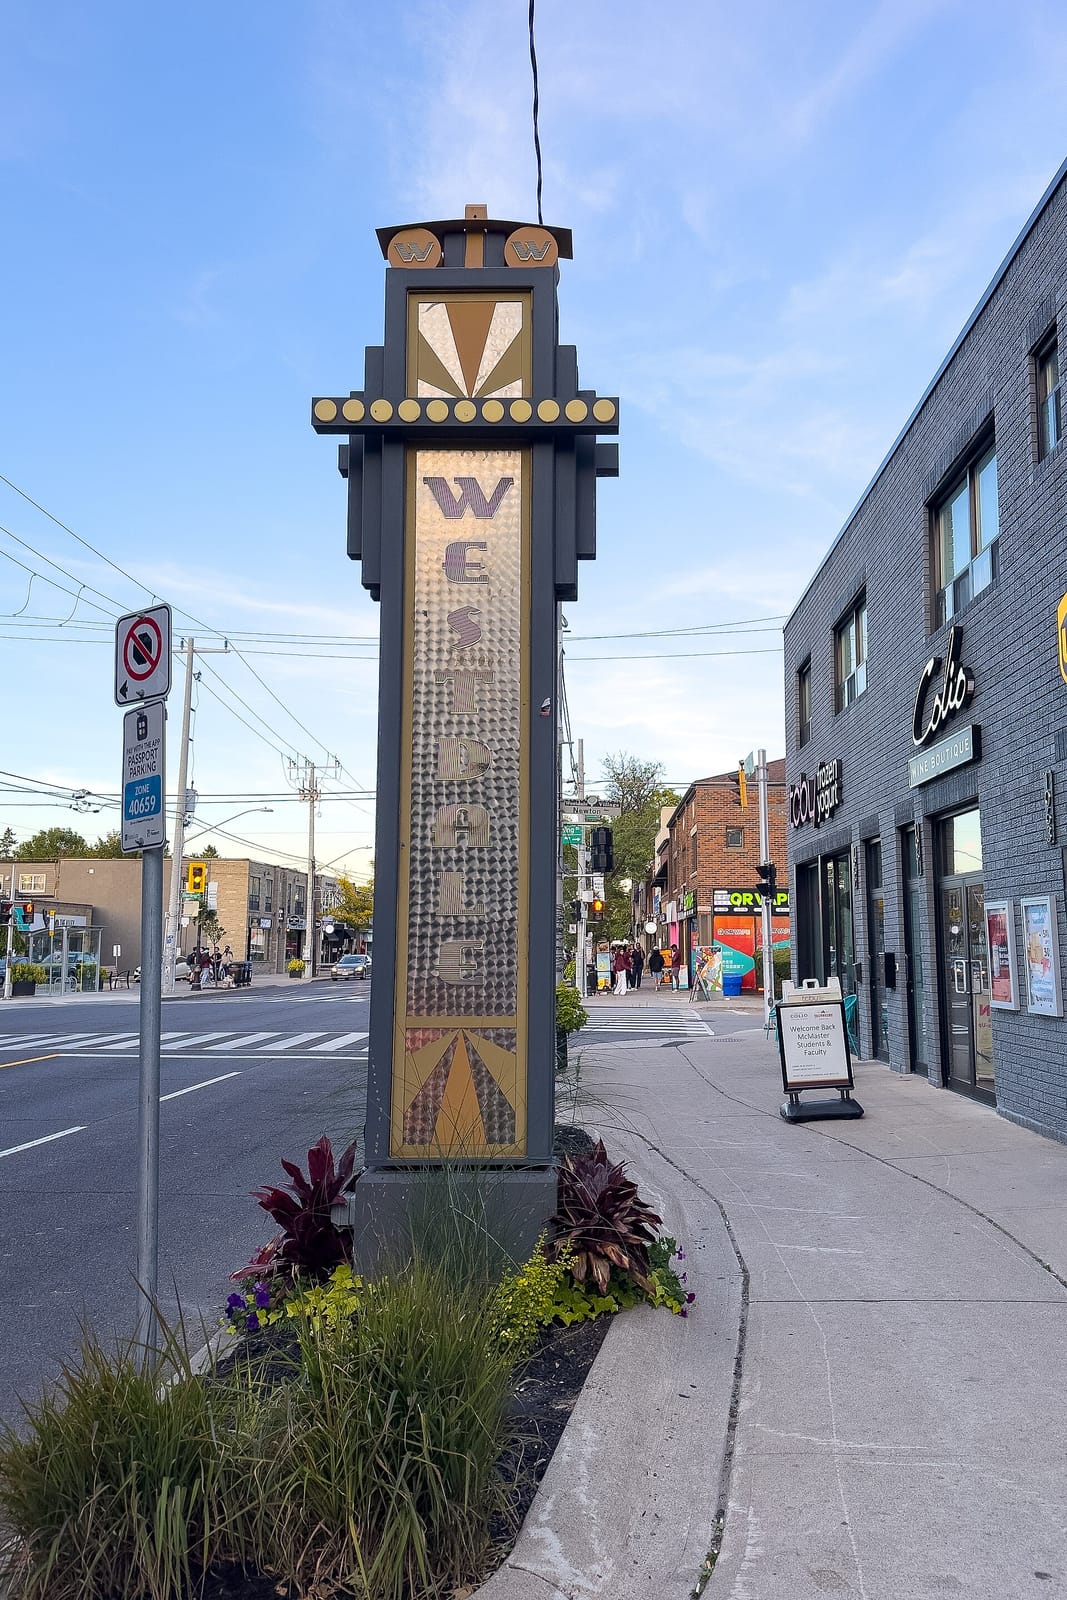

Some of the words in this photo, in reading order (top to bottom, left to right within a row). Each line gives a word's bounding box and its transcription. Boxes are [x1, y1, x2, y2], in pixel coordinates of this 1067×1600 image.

[394, 241, 433, 262] W
[511, 240, 551, 261] W
[912, 626, 966, 746] Colio
[422, 476, 514, 986] WESTDALE
[143, 742, 151, 750] THE
[151, 738, 160, 748] APP
[931, 738, 969, 769] BOUTIQUE
[127, 748, 158, 767] PASSPORT
[129, 761, 156, 778] PARKING
[816, 759, 838, 790] frozen
[134, 784, 150, 796] ZONE
[128, 795, 156, 816] 40659
[573, 807, 601, 815] Newton
[816, 780, 839, 822] yogurt
[730, 892, 754, 906] QR
[797, 1032, 830, 1040] McMaster
[821, 1023, 836, 1031] Back
